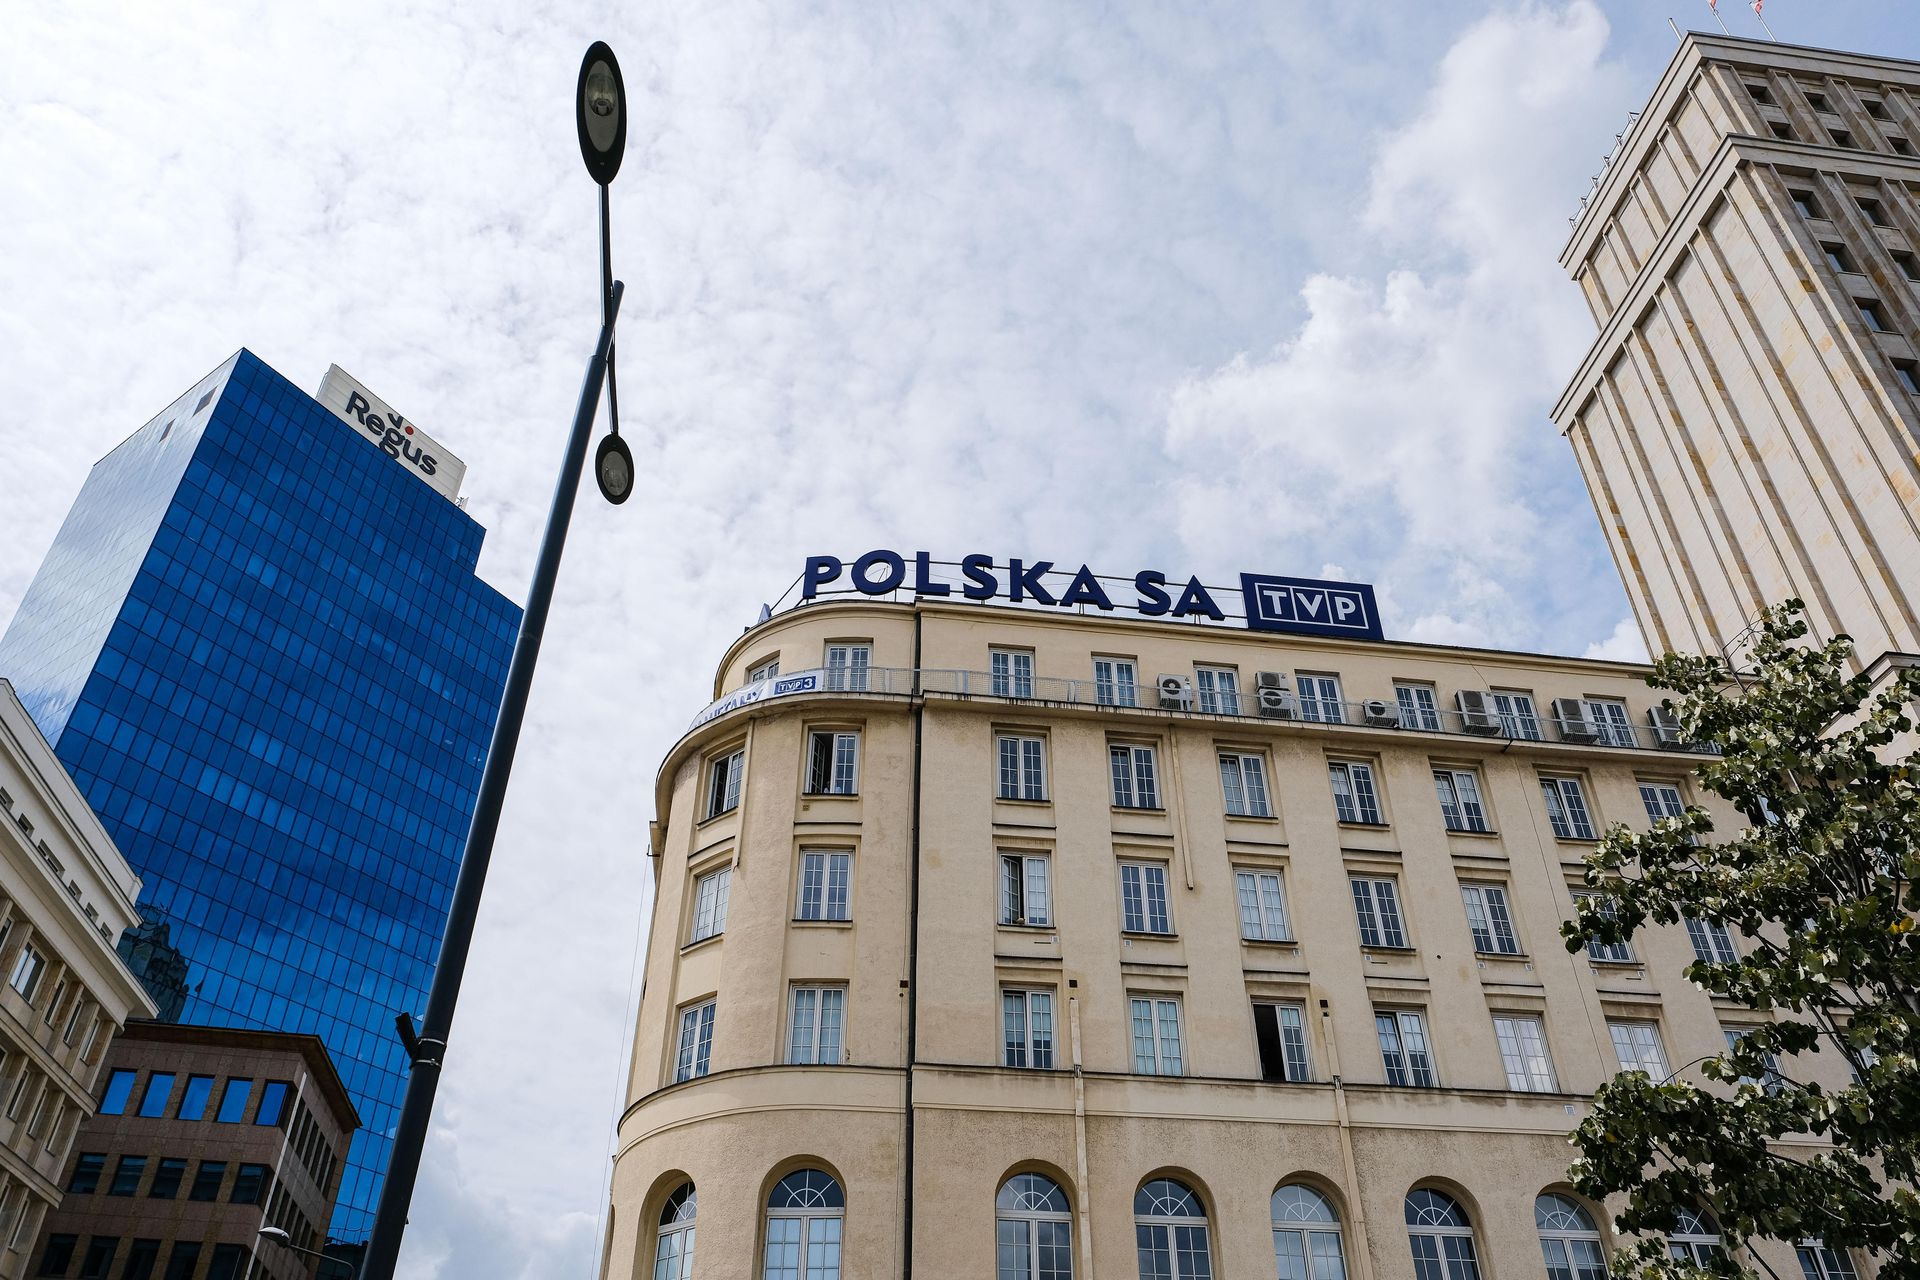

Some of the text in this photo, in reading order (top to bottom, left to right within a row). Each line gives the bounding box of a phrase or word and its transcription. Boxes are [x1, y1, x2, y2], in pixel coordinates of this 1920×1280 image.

[345, 390, 438, 476] Regus
[802, 549, 1356, 621] POLSKA SA TVP
